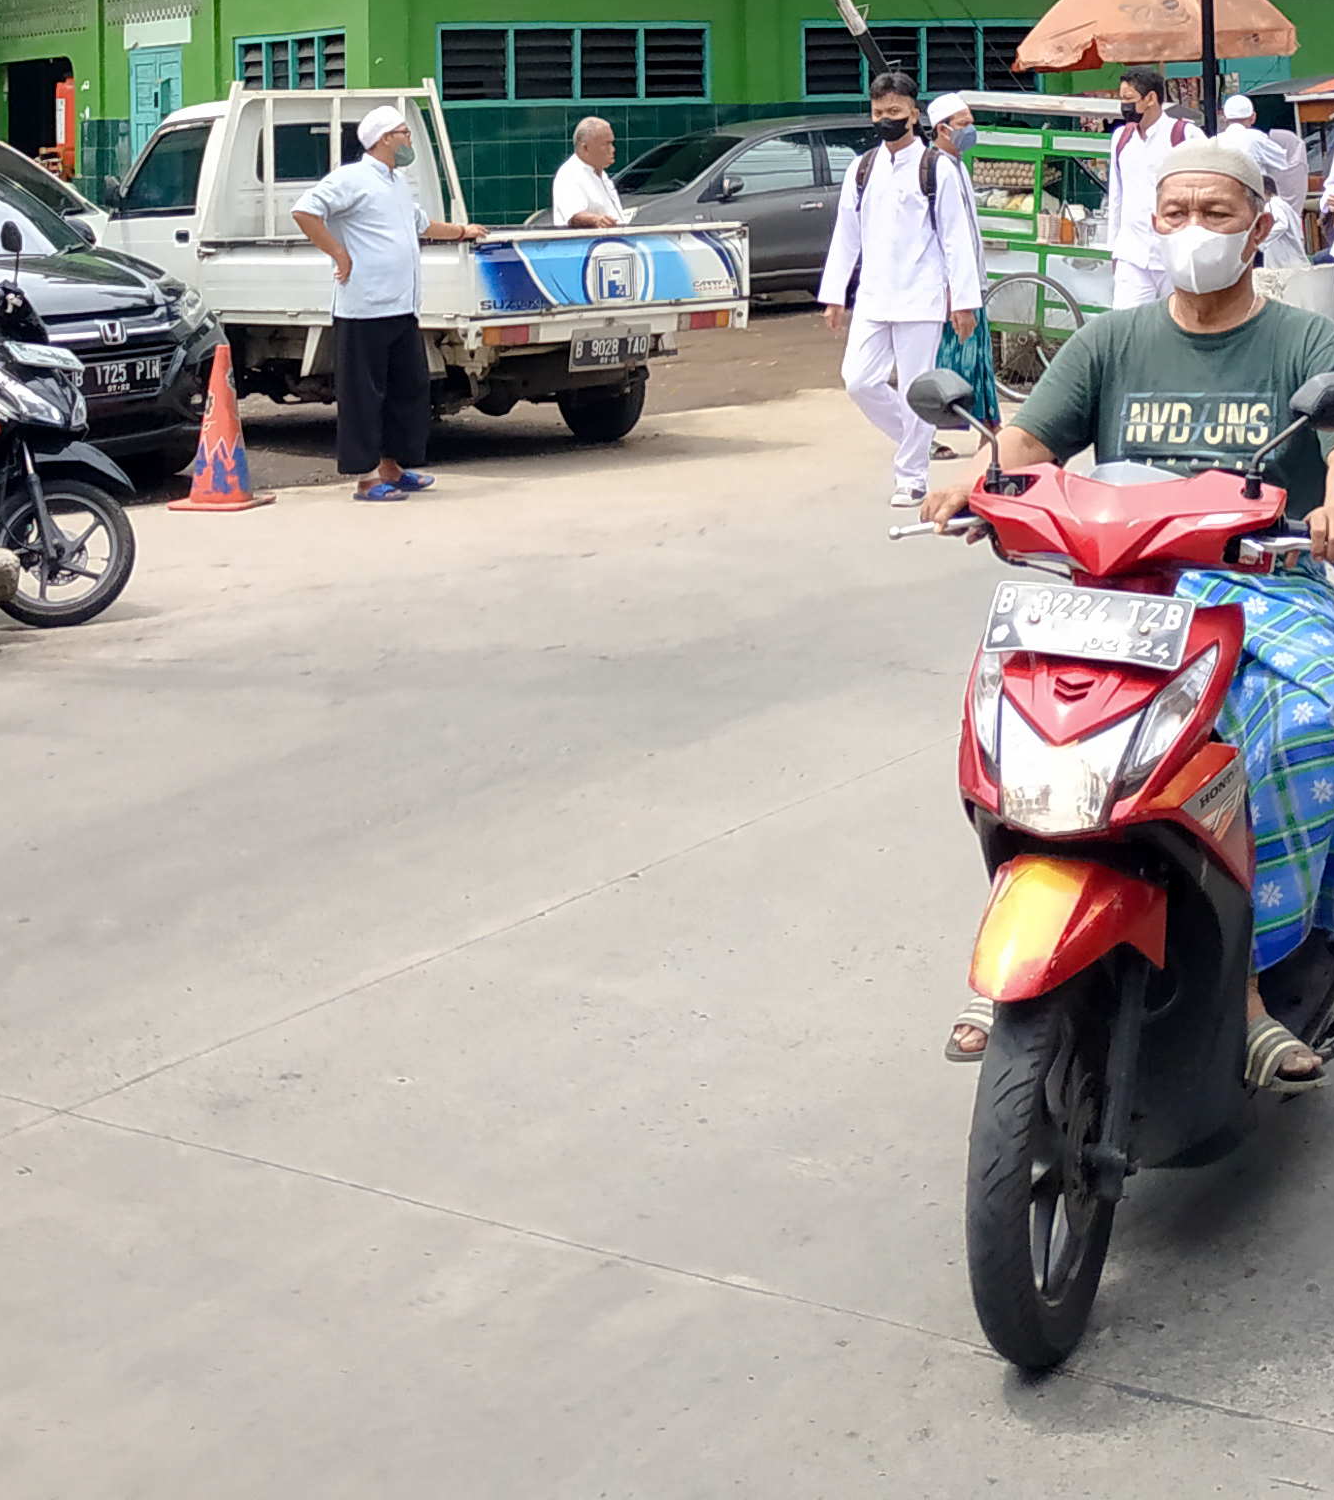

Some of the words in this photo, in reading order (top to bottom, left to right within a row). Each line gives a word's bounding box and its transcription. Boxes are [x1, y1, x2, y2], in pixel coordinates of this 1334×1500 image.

[573, 340, 584, 359] B
[590, 338, 620, 358] 9028
[95, 362, 128, 386] 1725
[135, 359, 161, 381] PIN
[996, 586, 1017, 614] B
[1127, 599, 1185, 631] TZB
